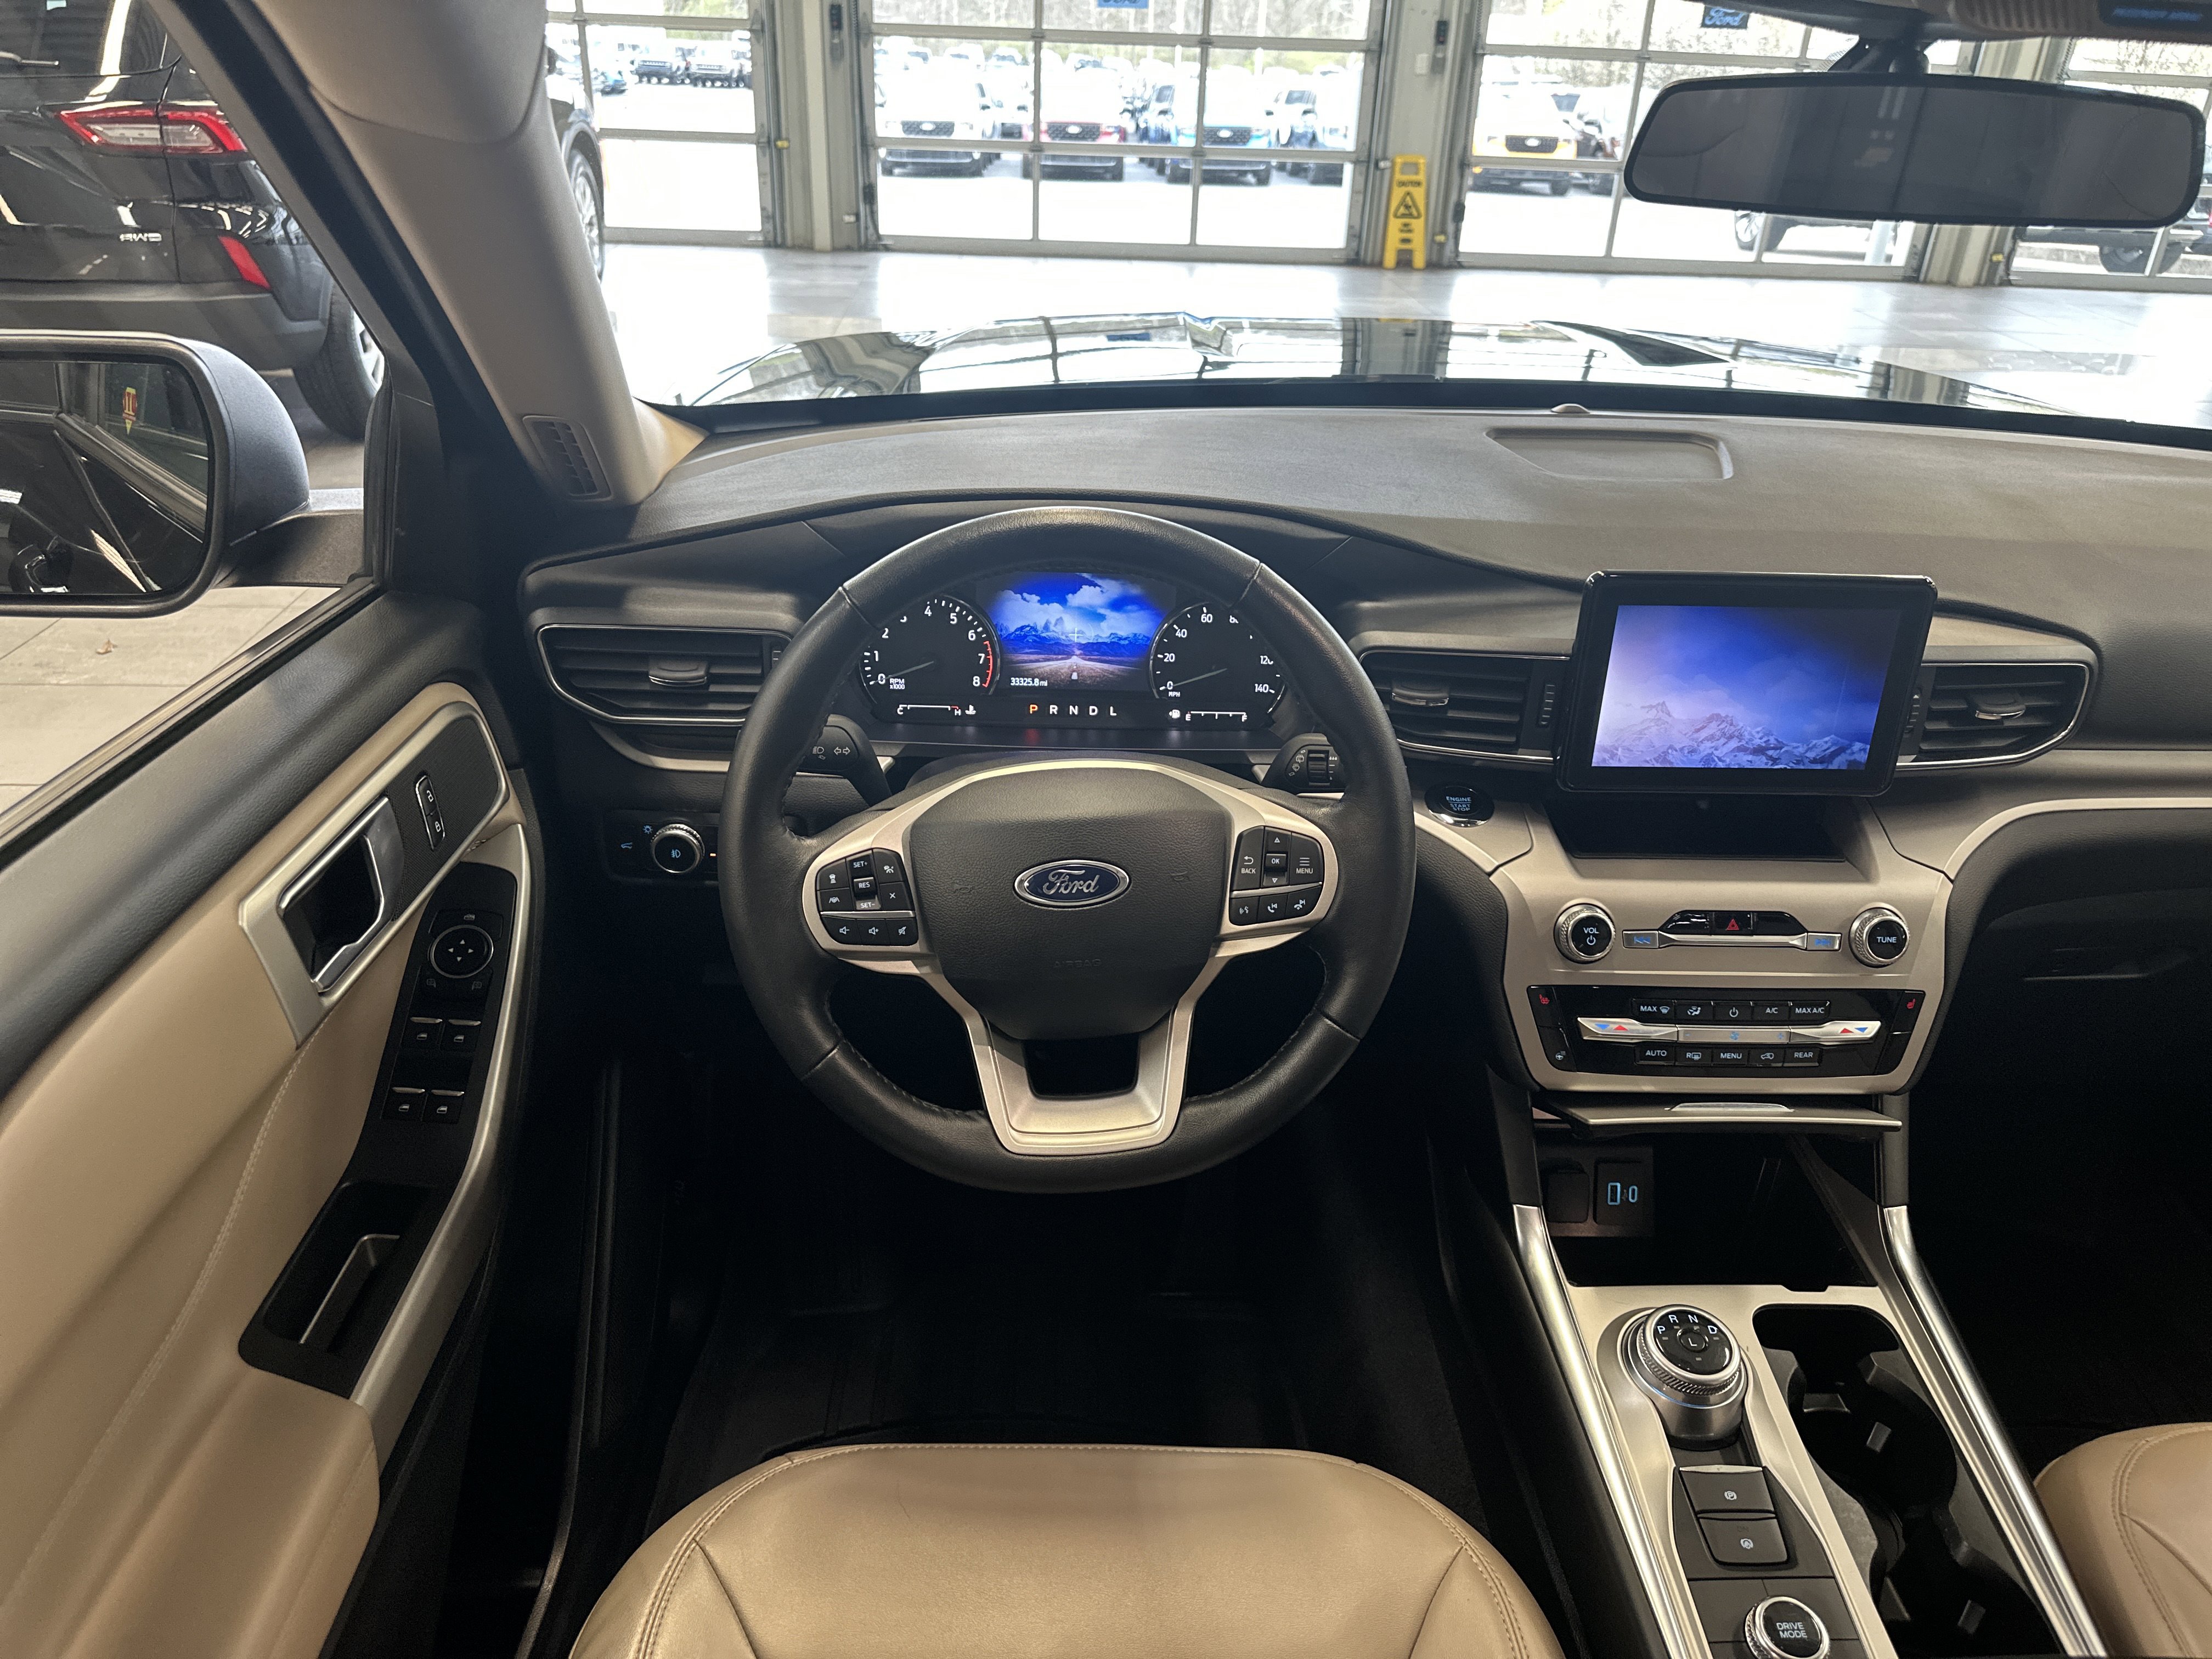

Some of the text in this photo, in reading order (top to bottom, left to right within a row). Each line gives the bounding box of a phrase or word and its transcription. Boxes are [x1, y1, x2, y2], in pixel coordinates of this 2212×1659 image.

[924, 606, 932, 617] 4
[950, 613, 957, 624] 5
[1201, 613, 1213, 623] 60
[882, 628, 889, 639] 2
[968, 630, 976, 641] 6
[1175, 629, 1187, 638] 40
[874, 650, 878, 662] 1
[978, 653, 985, 664] 7
[1164, 653, 1175, 662] 20
[878, 673, 886, 684] 0
[973, 676, 980, 686] 8
[1167, 681, 1173, 690] 0
[1255, 684, 1269, 693] 140
[1030, 704, 1117, 716] P R N D L
[1042, 869, 1100, 895] Ford
[1657, 1314, 1718, 1334] P R N D
[1688, 1338, 1697, 1347] L
[1779, 1630, 1808, 1638] MODE
